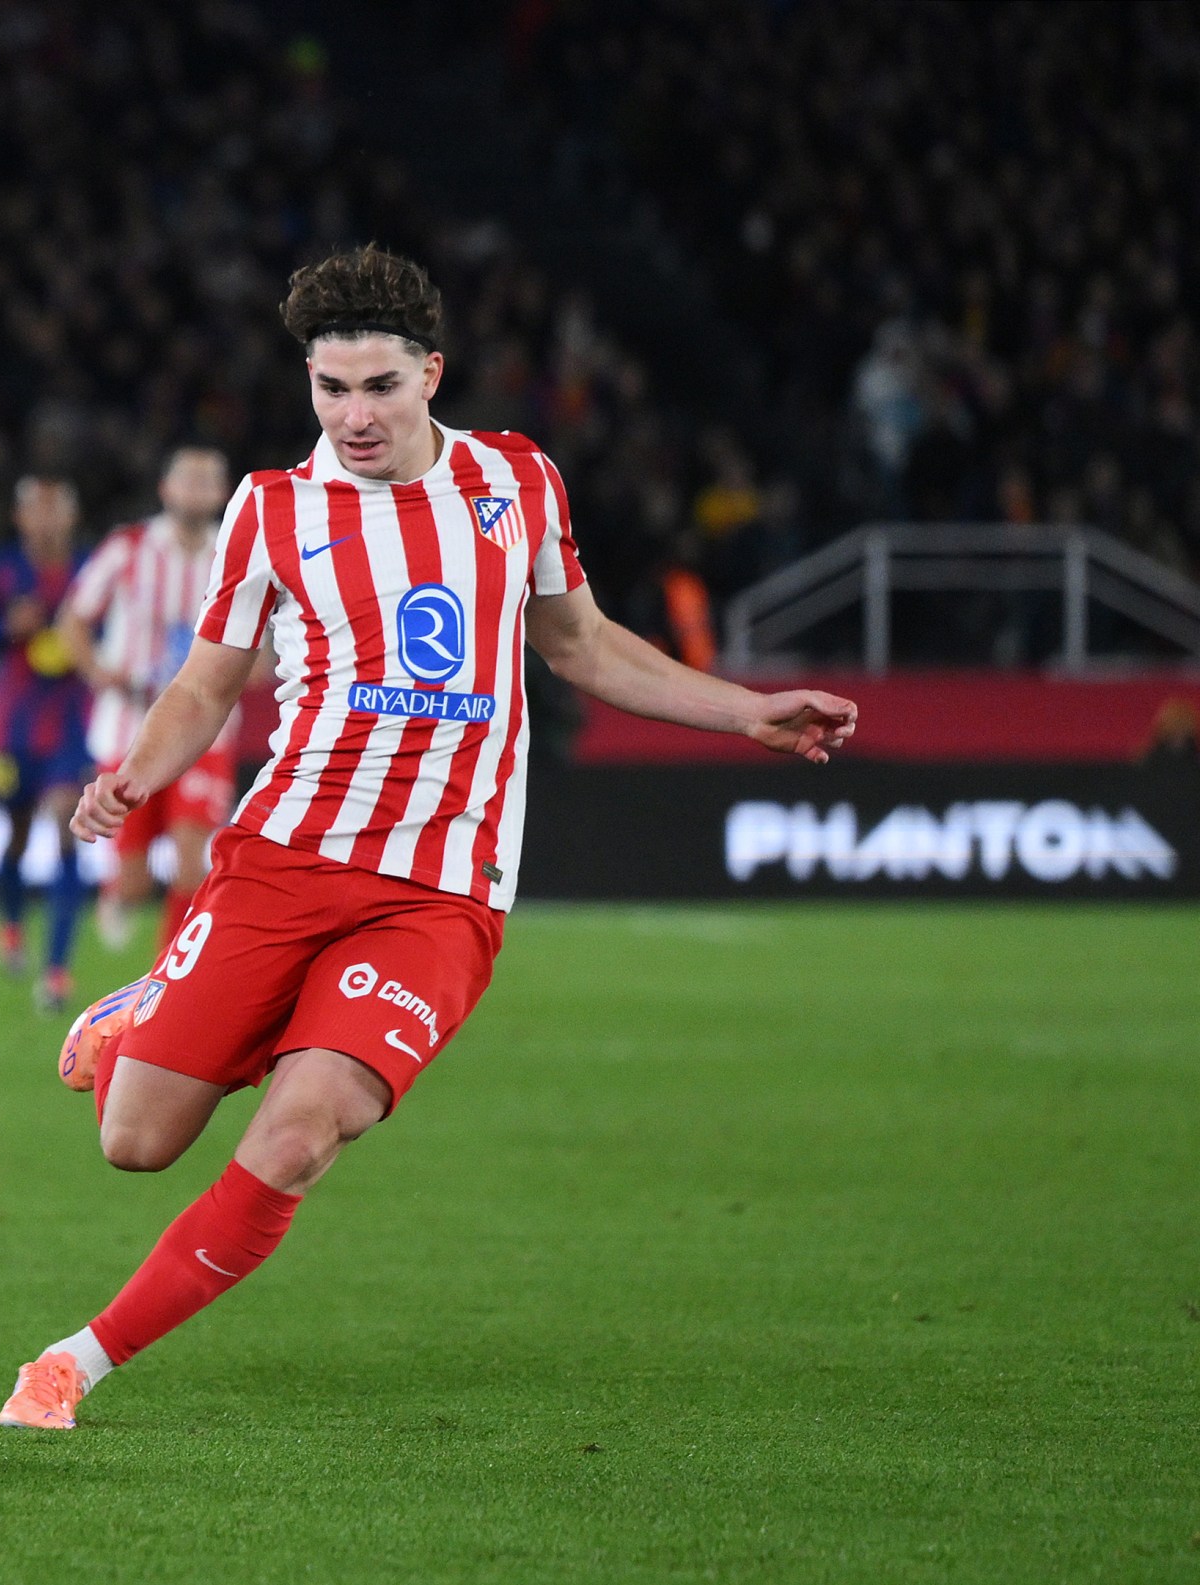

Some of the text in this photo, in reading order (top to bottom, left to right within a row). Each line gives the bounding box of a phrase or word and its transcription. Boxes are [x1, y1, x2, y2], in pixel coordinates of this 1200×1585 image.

[354, 686, 491, 719] RIYADH AIR
[725, 799, 1177, 882] PHANTOM
[154, 906, 213, 981] 9
